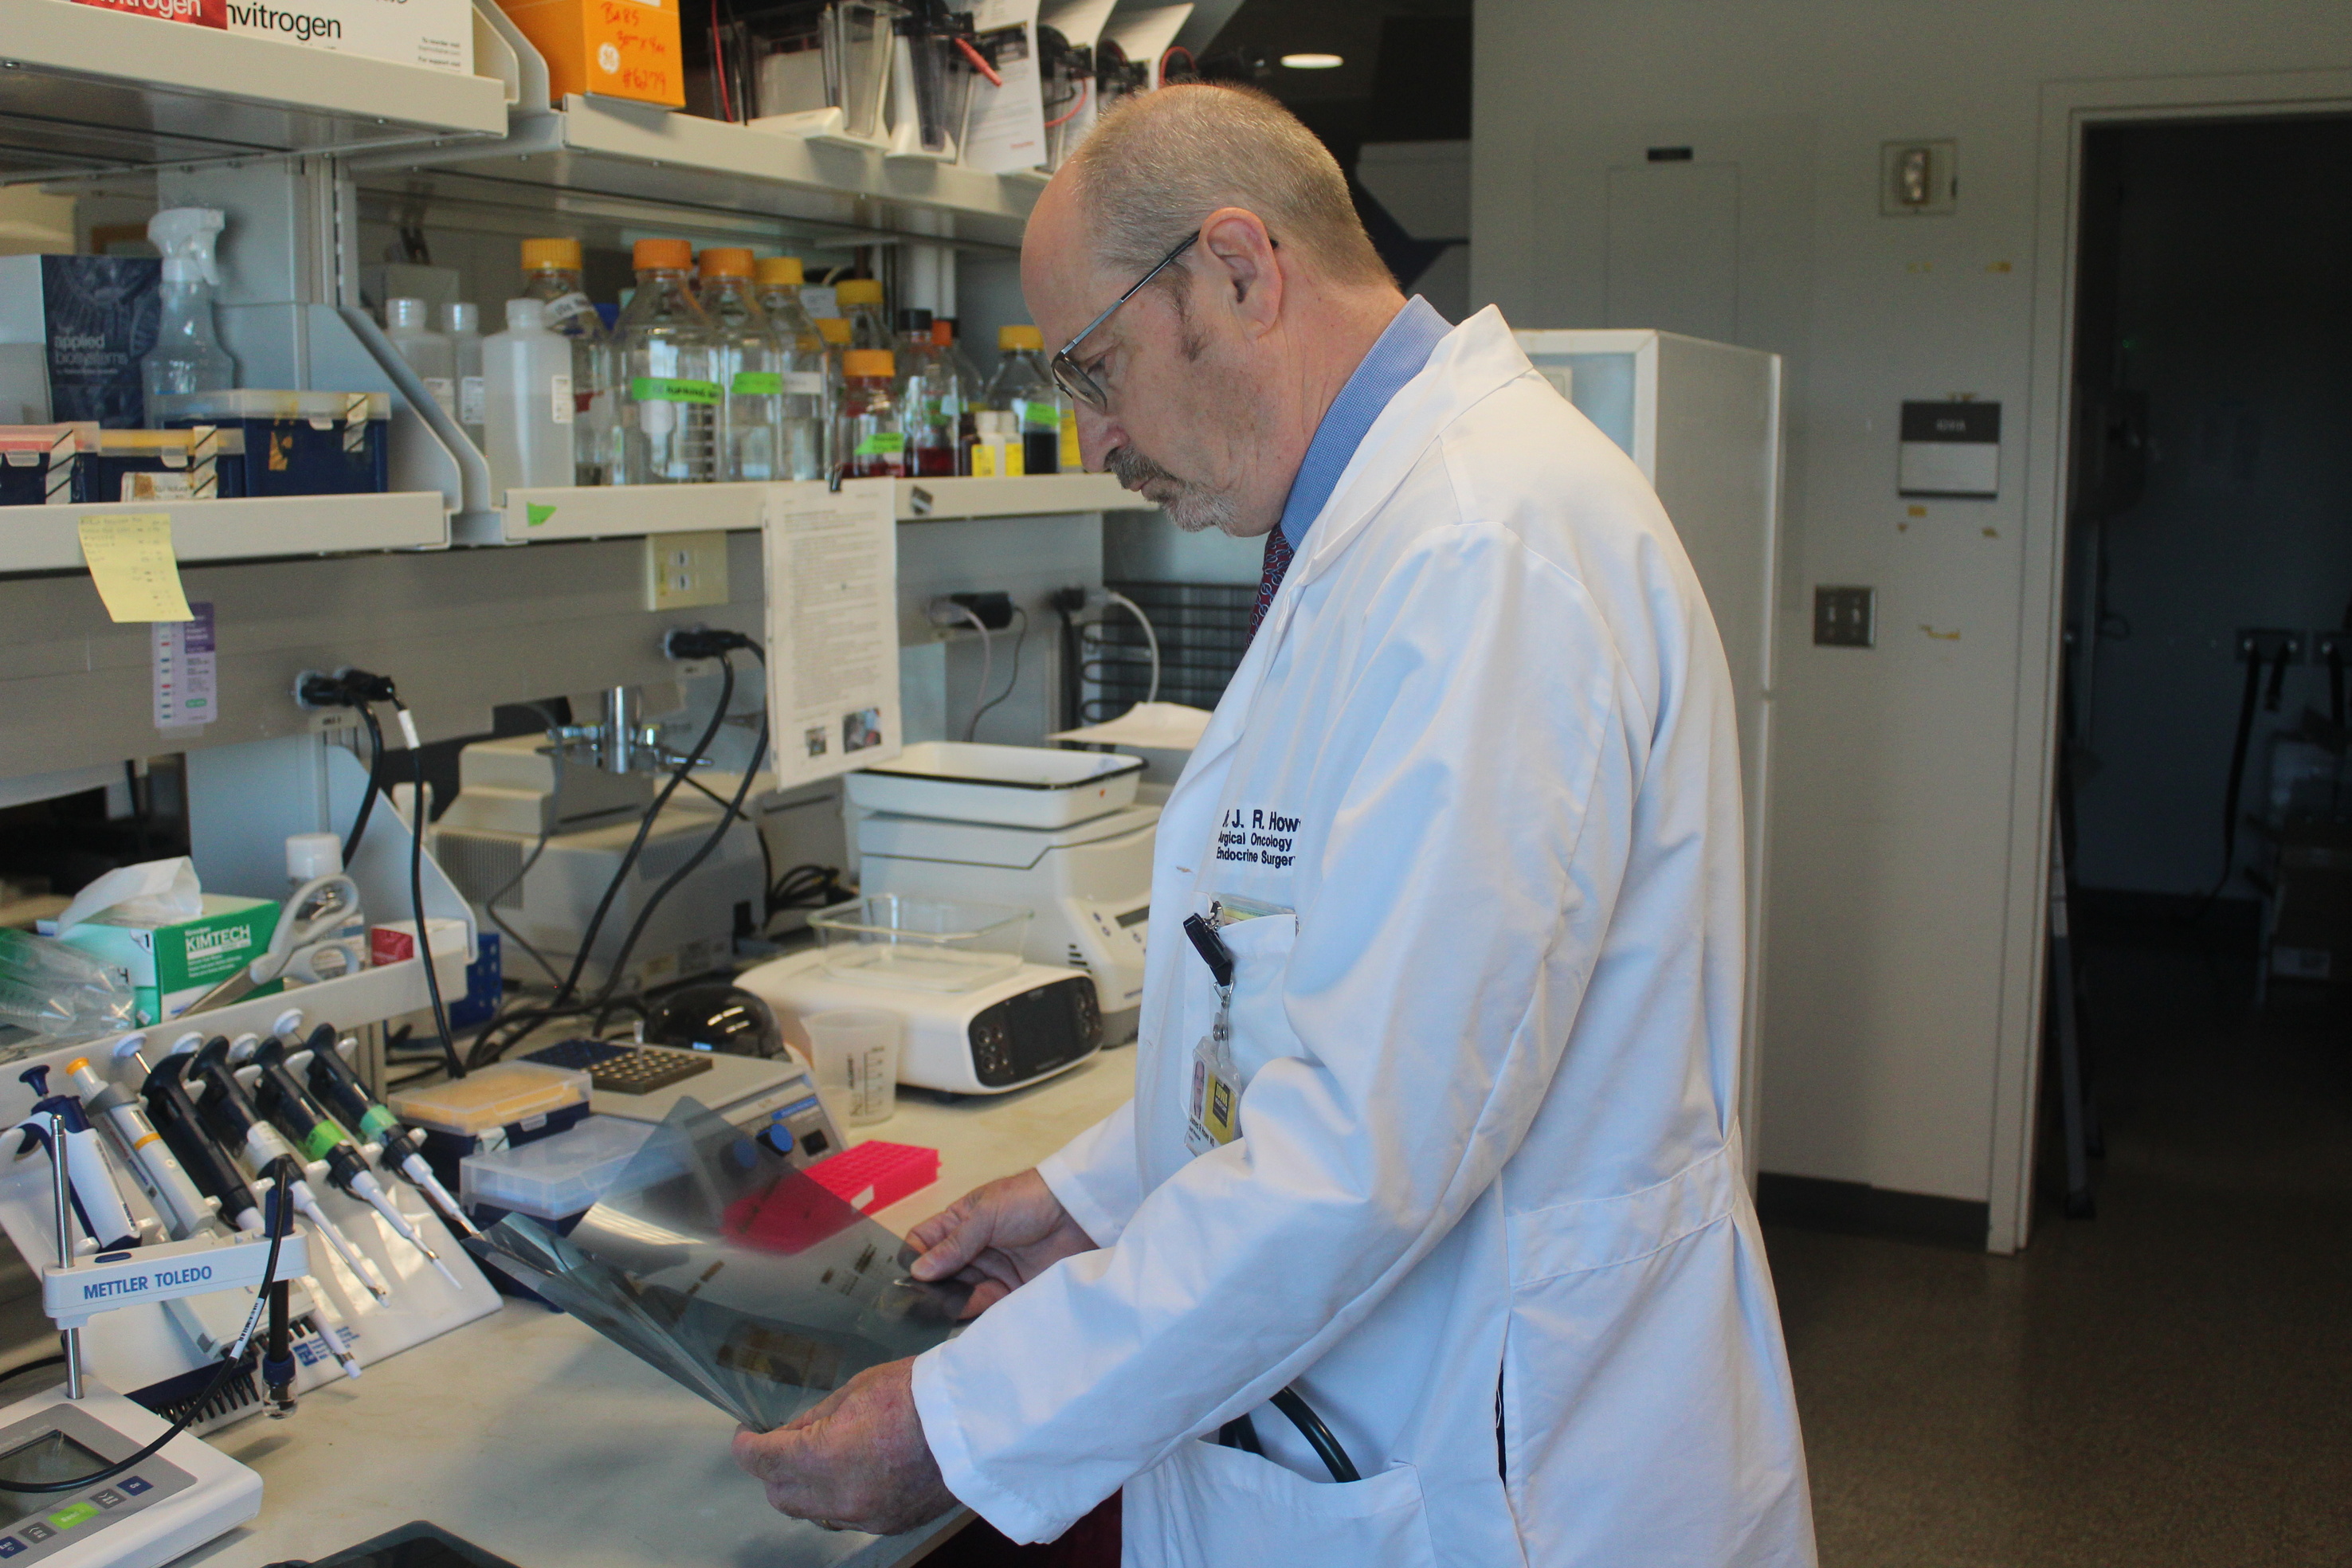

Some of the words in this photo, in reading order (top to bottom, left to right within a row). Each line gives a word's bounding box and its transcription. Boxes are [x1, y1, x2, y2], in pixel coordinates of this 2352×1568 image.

[226, 2, 341, 41] nvitrogen
[1231, 809, 1245, 829] J.
[1252, 809, 1265, 830] R.
[1217, 830, 1246, 847] rgical
[1250, 833, 1292, 852] Oncology
[1216, 846, 1259, 863] Endocrine
[185, 924, 251, 953] KIMTECH
[84, 1276, 148, 1299] METTLER
[155, 1265, 213, 1288] TOLEDO
